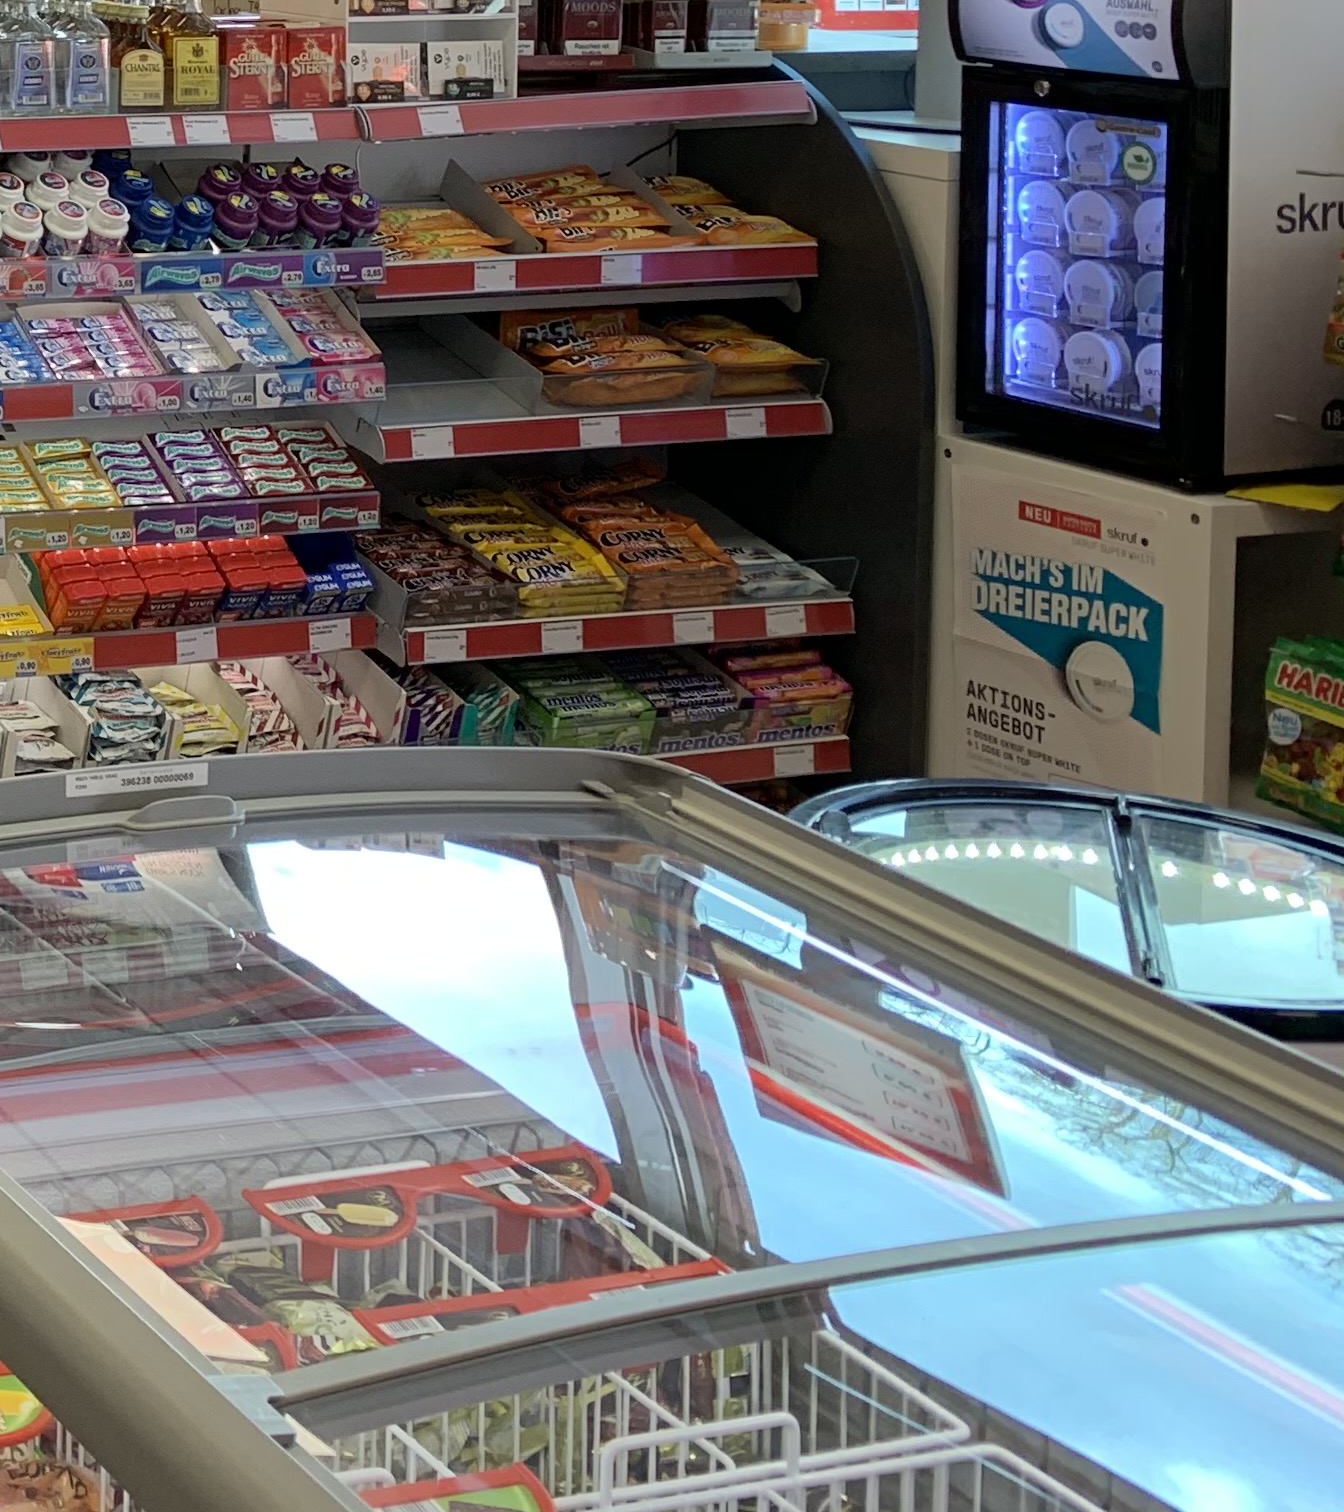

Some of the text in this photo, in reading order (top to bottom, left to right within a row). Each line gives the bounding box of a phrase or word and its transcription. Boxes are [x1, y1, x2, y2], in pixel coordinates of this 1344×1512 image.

[1025, 504, 1052, 524] NEU
[1107, 526, 1137, 545] skruf
[511, 560, 576, 583] CORNY
[970, 547, 1104, 594] MACH'S IM
[971, 581, 1150, 642] DREIERPACK
[967, 680, 1056, 722] AKTIONS-
[759, 723, 836, 742] mentos
[967, 704, 1045, 744] ANGEBOT
